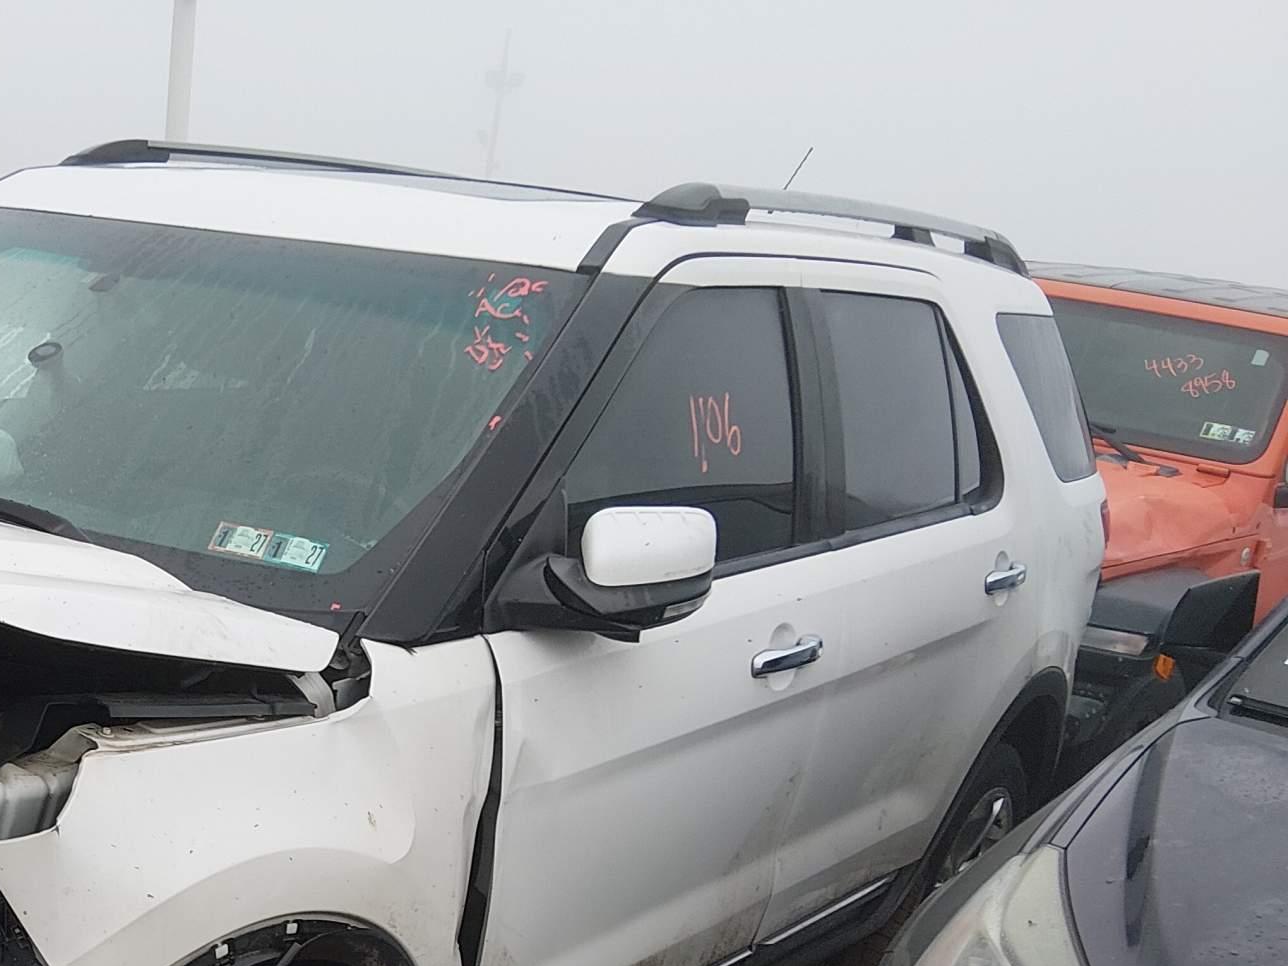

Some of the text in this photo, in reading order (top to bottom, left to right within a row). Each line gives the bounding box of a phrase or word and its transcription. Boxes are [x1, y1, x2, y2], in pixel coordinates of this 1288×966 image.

[1144, 354, 1204, 378] 4433
[1180, 369, 1236, 398] 8958
[250, 533, 268, 553] 27
[304, 545, 325, 566] 27
